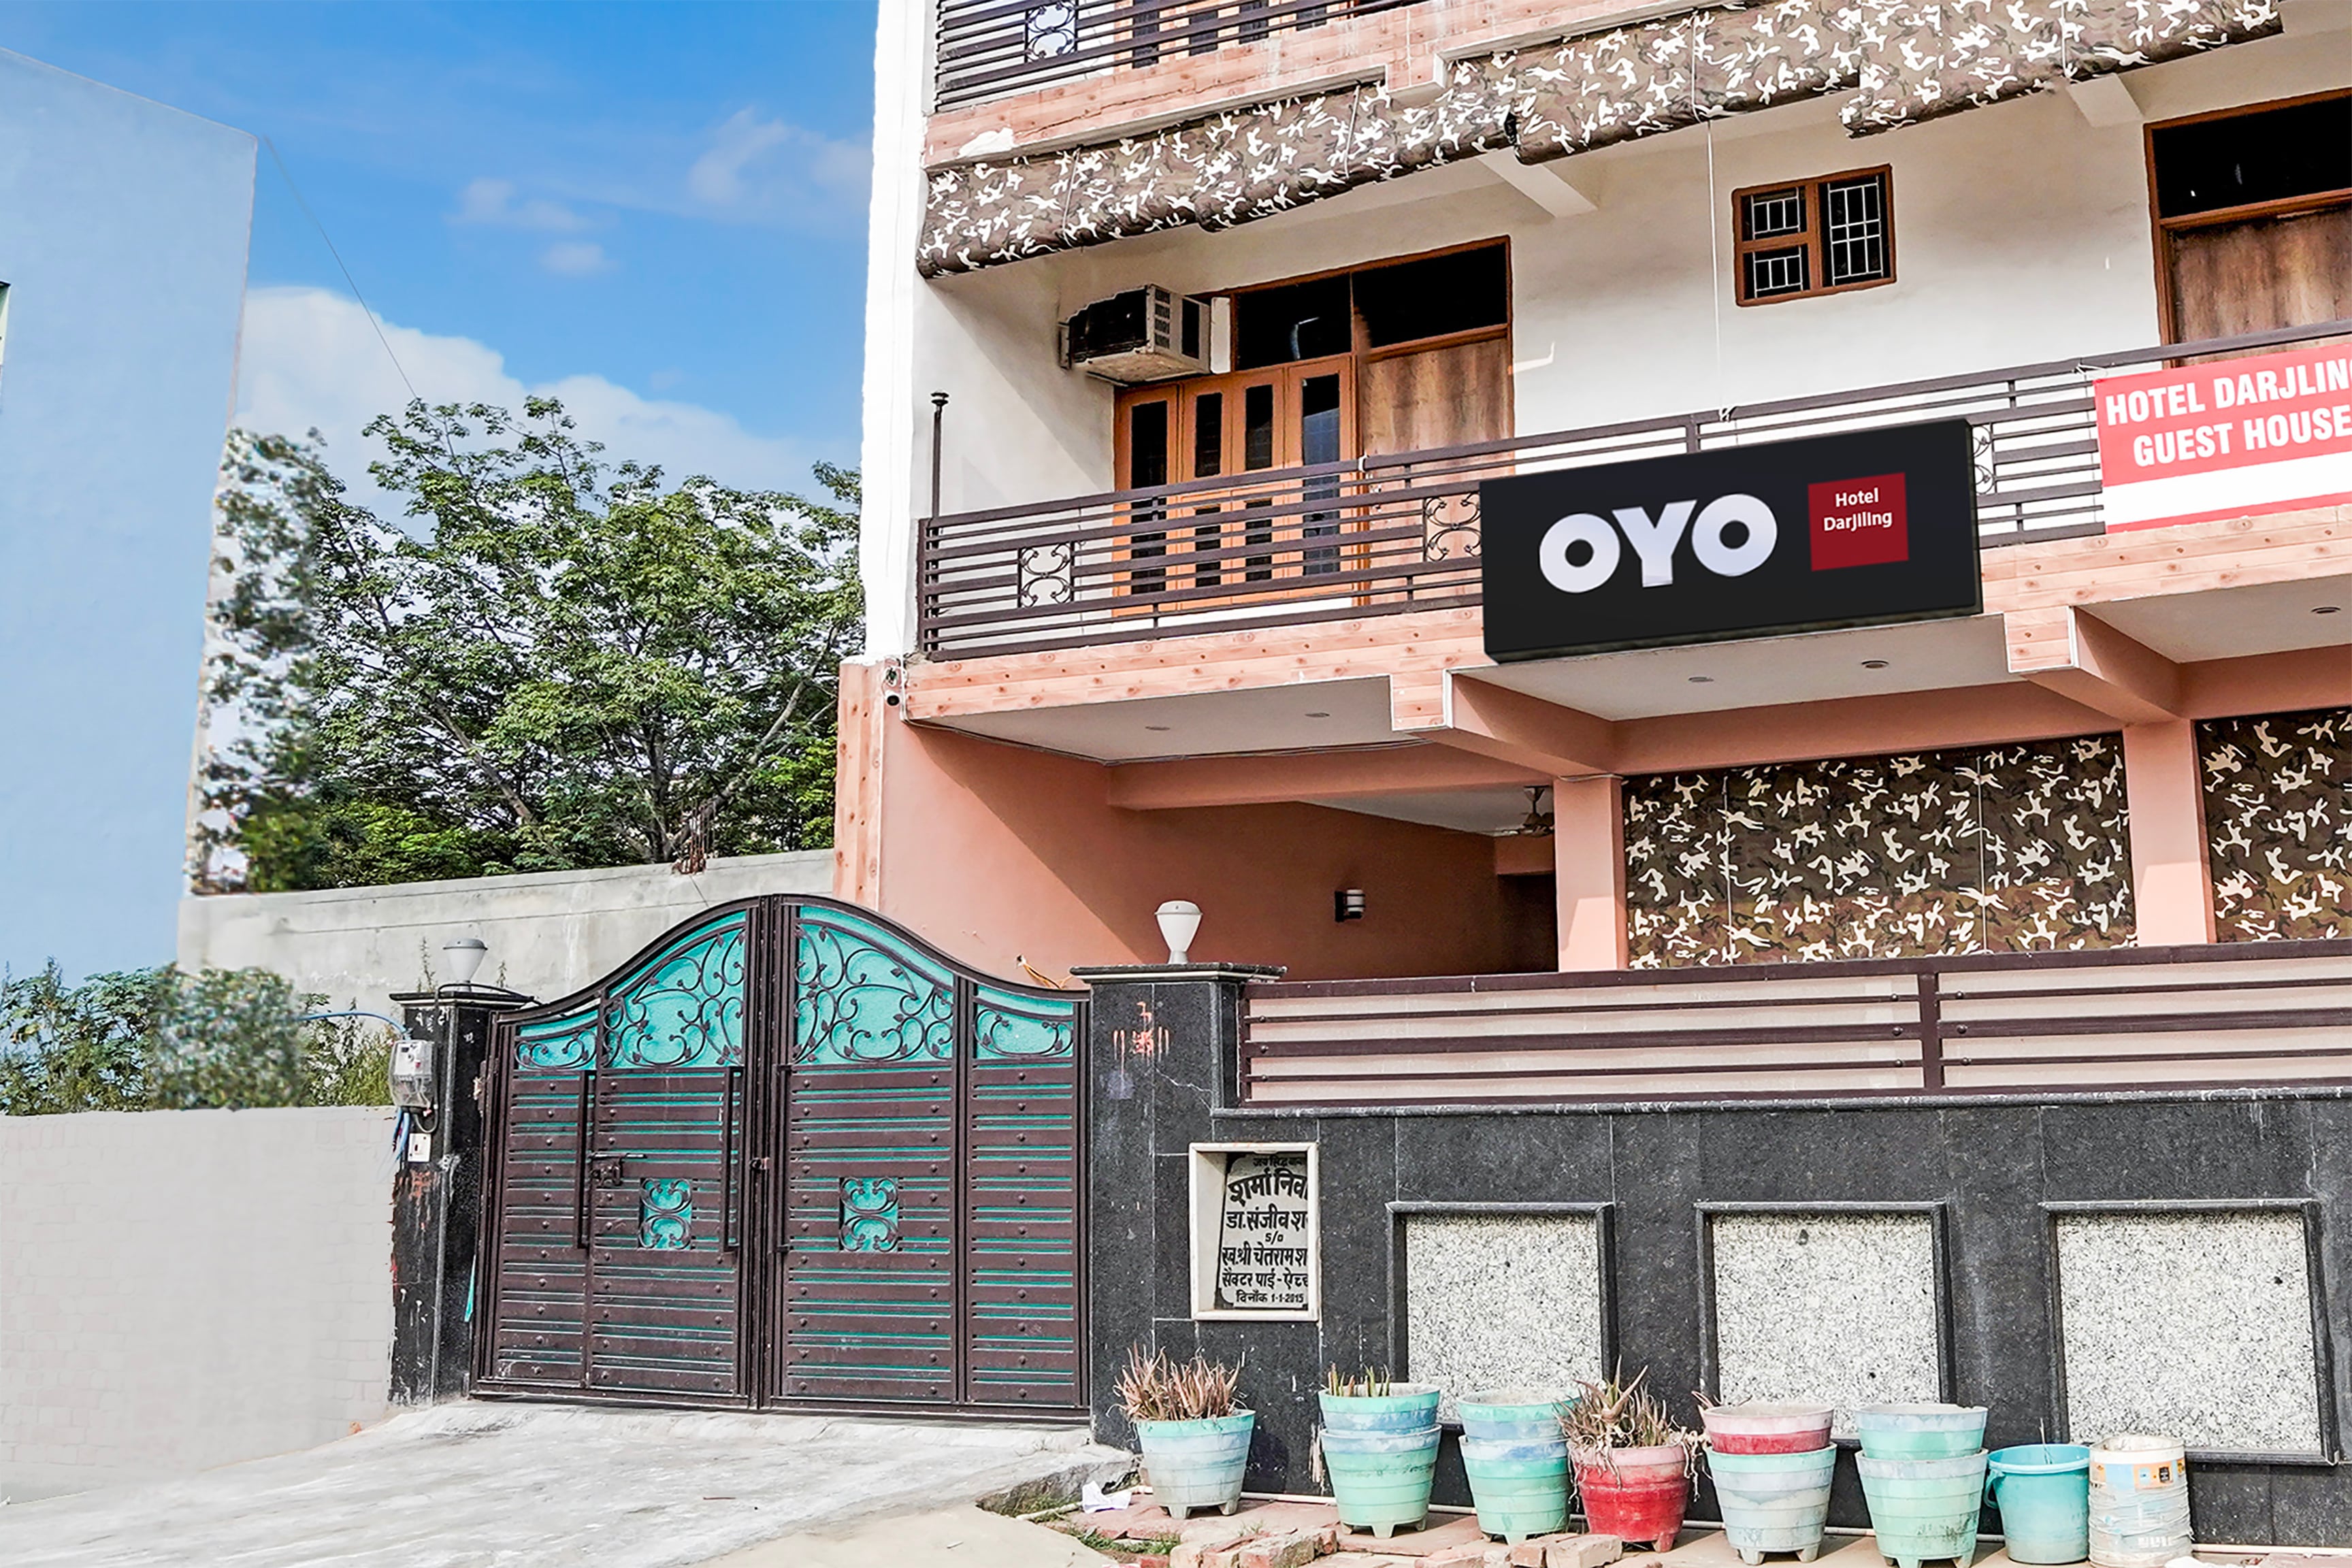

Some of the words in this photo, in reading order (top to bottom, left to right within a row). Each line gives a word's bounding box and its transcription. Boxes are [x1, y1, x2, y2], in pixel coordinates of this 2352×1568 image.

[2106, 382, 2205, 426] HOTEL
[2213, 358, 2352, 409] DARJLIN
[2133, 423, 2233, 467] GUEST
[2243, 404, 2352, 451] HOUSE
[1835, 487, 1879, 507] Hotel
[1539, 493, 1778, 593] OYO
